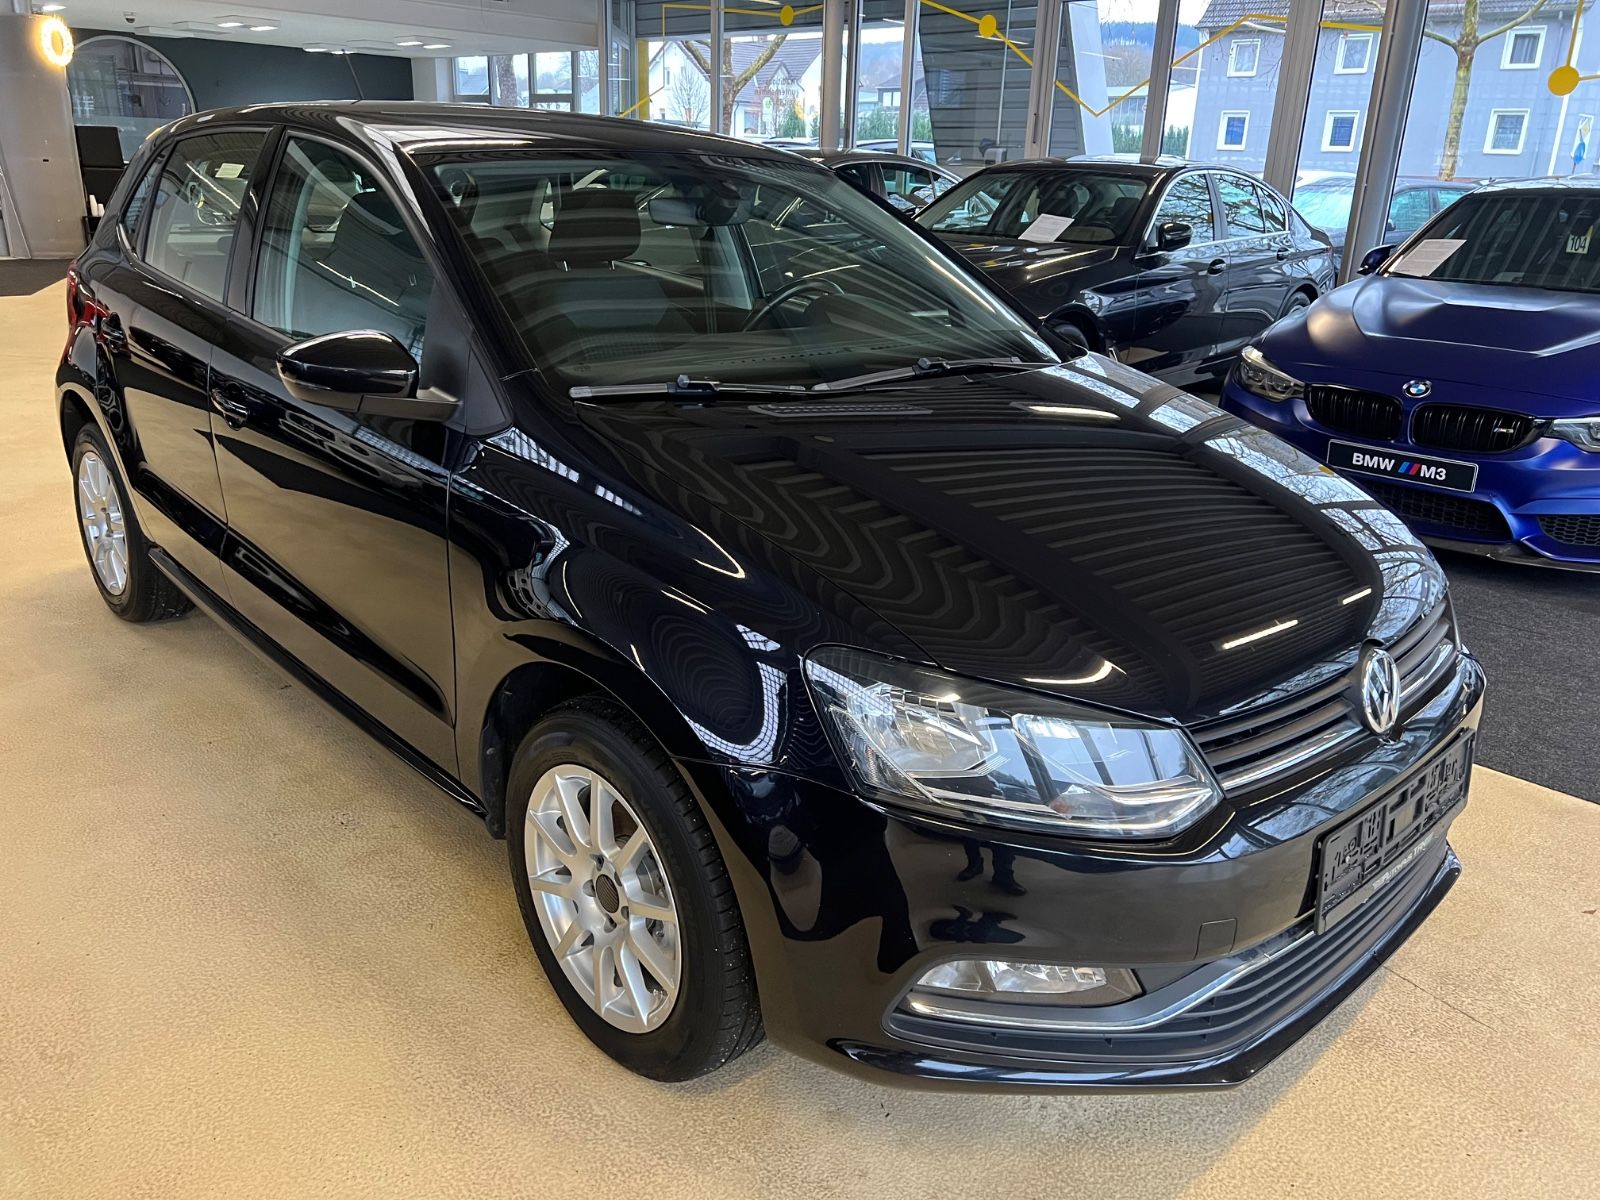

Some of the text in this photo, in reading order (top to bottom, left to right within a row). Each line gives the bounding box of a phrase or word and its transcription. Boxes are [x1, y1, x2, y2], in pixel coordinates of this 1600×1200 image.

[1570, 234, 1587, 252] 104
[1352, 452, 1447, 480] BMW M3
